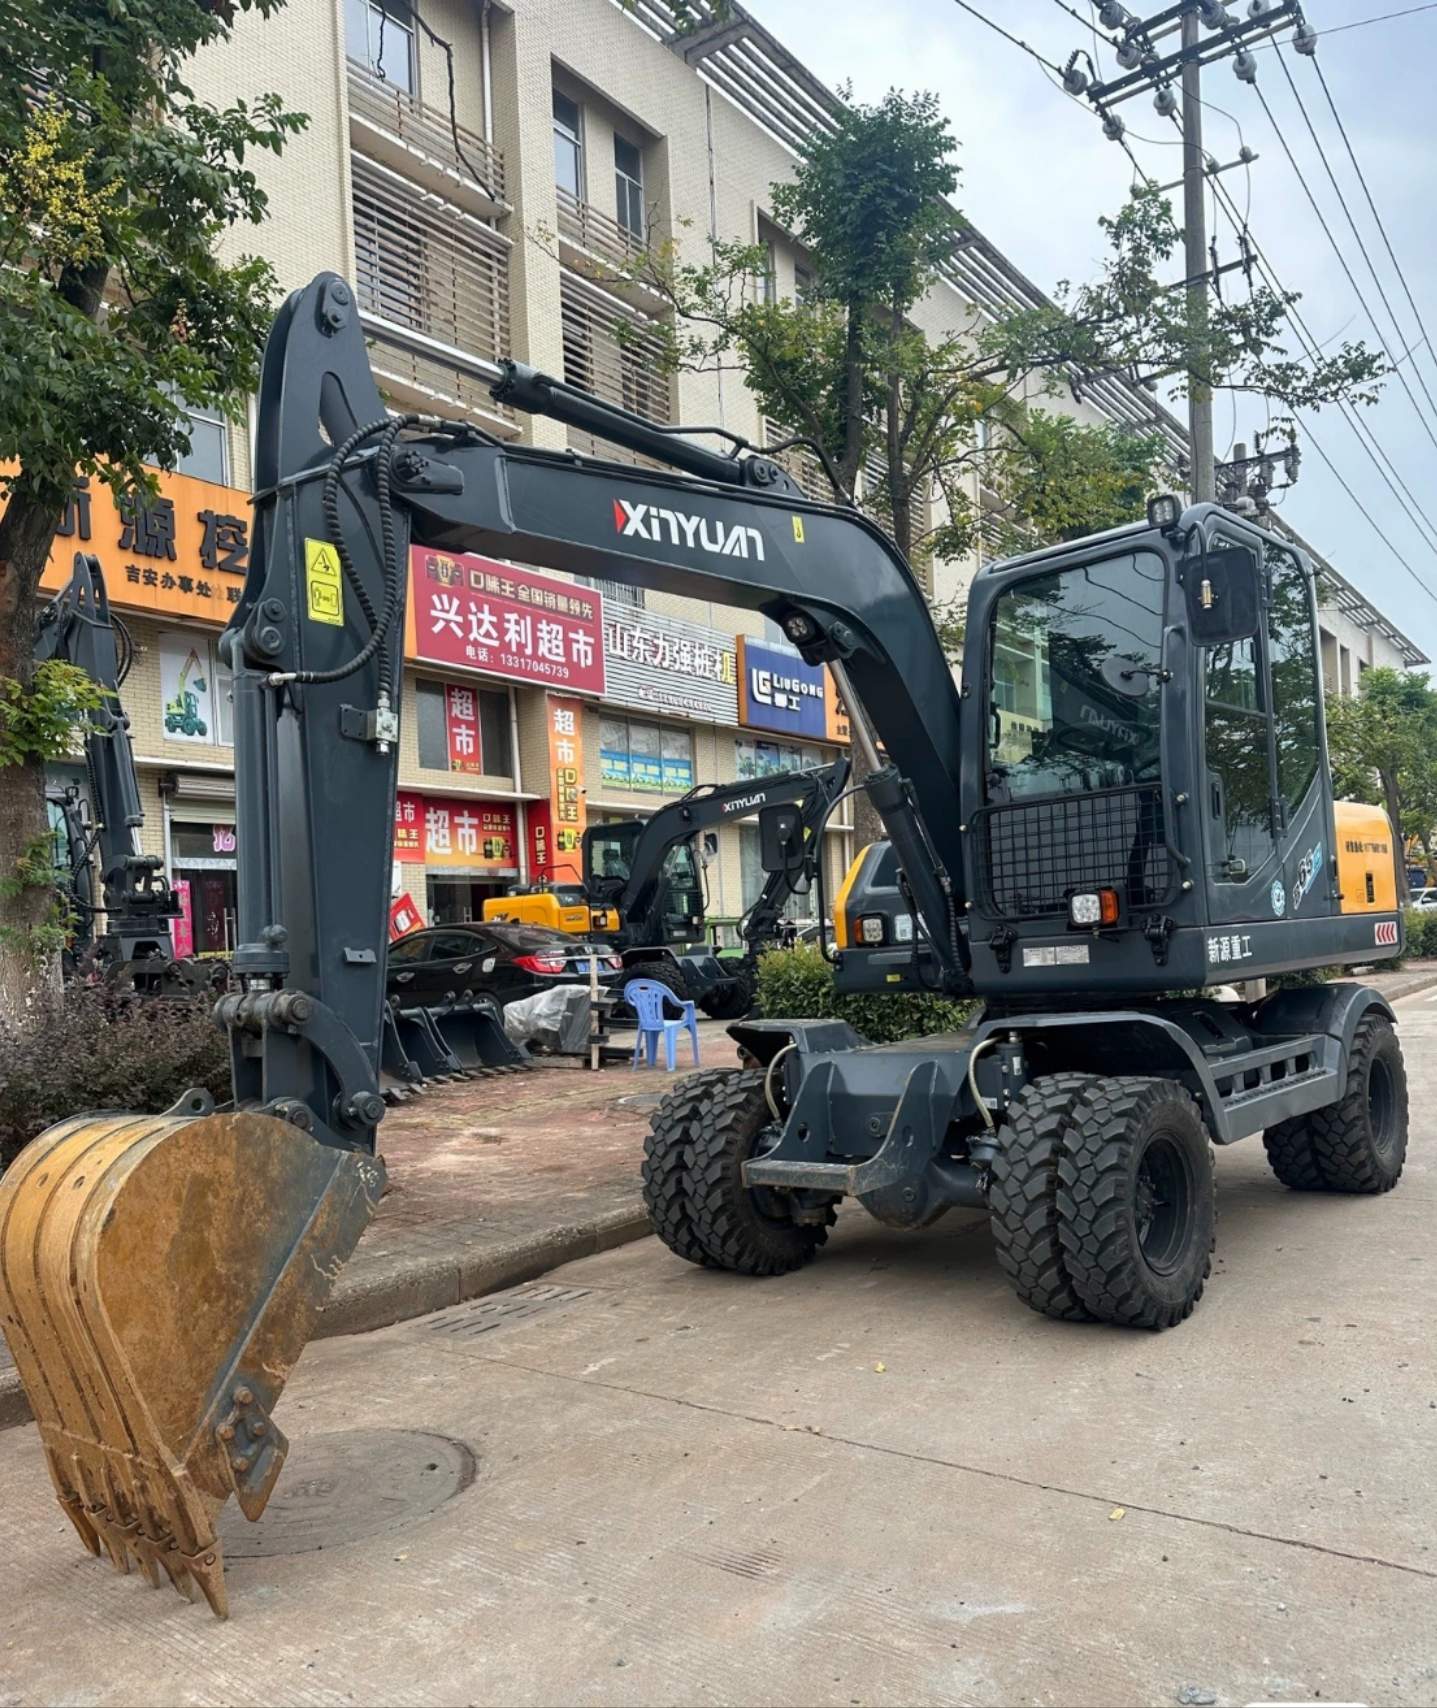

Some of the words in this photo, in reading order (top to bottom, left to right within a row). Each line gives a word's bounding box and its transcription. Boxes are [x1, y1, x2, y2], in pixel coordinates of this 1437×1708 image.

[125, 564, 212, 598] 吉安办事处
[430, 593, 595, 668] 兴达利超市
[450, 687, 475, 756] 超市
[553, 708, 576, 764] 超市
[425, 806, 479, 856] 超市
